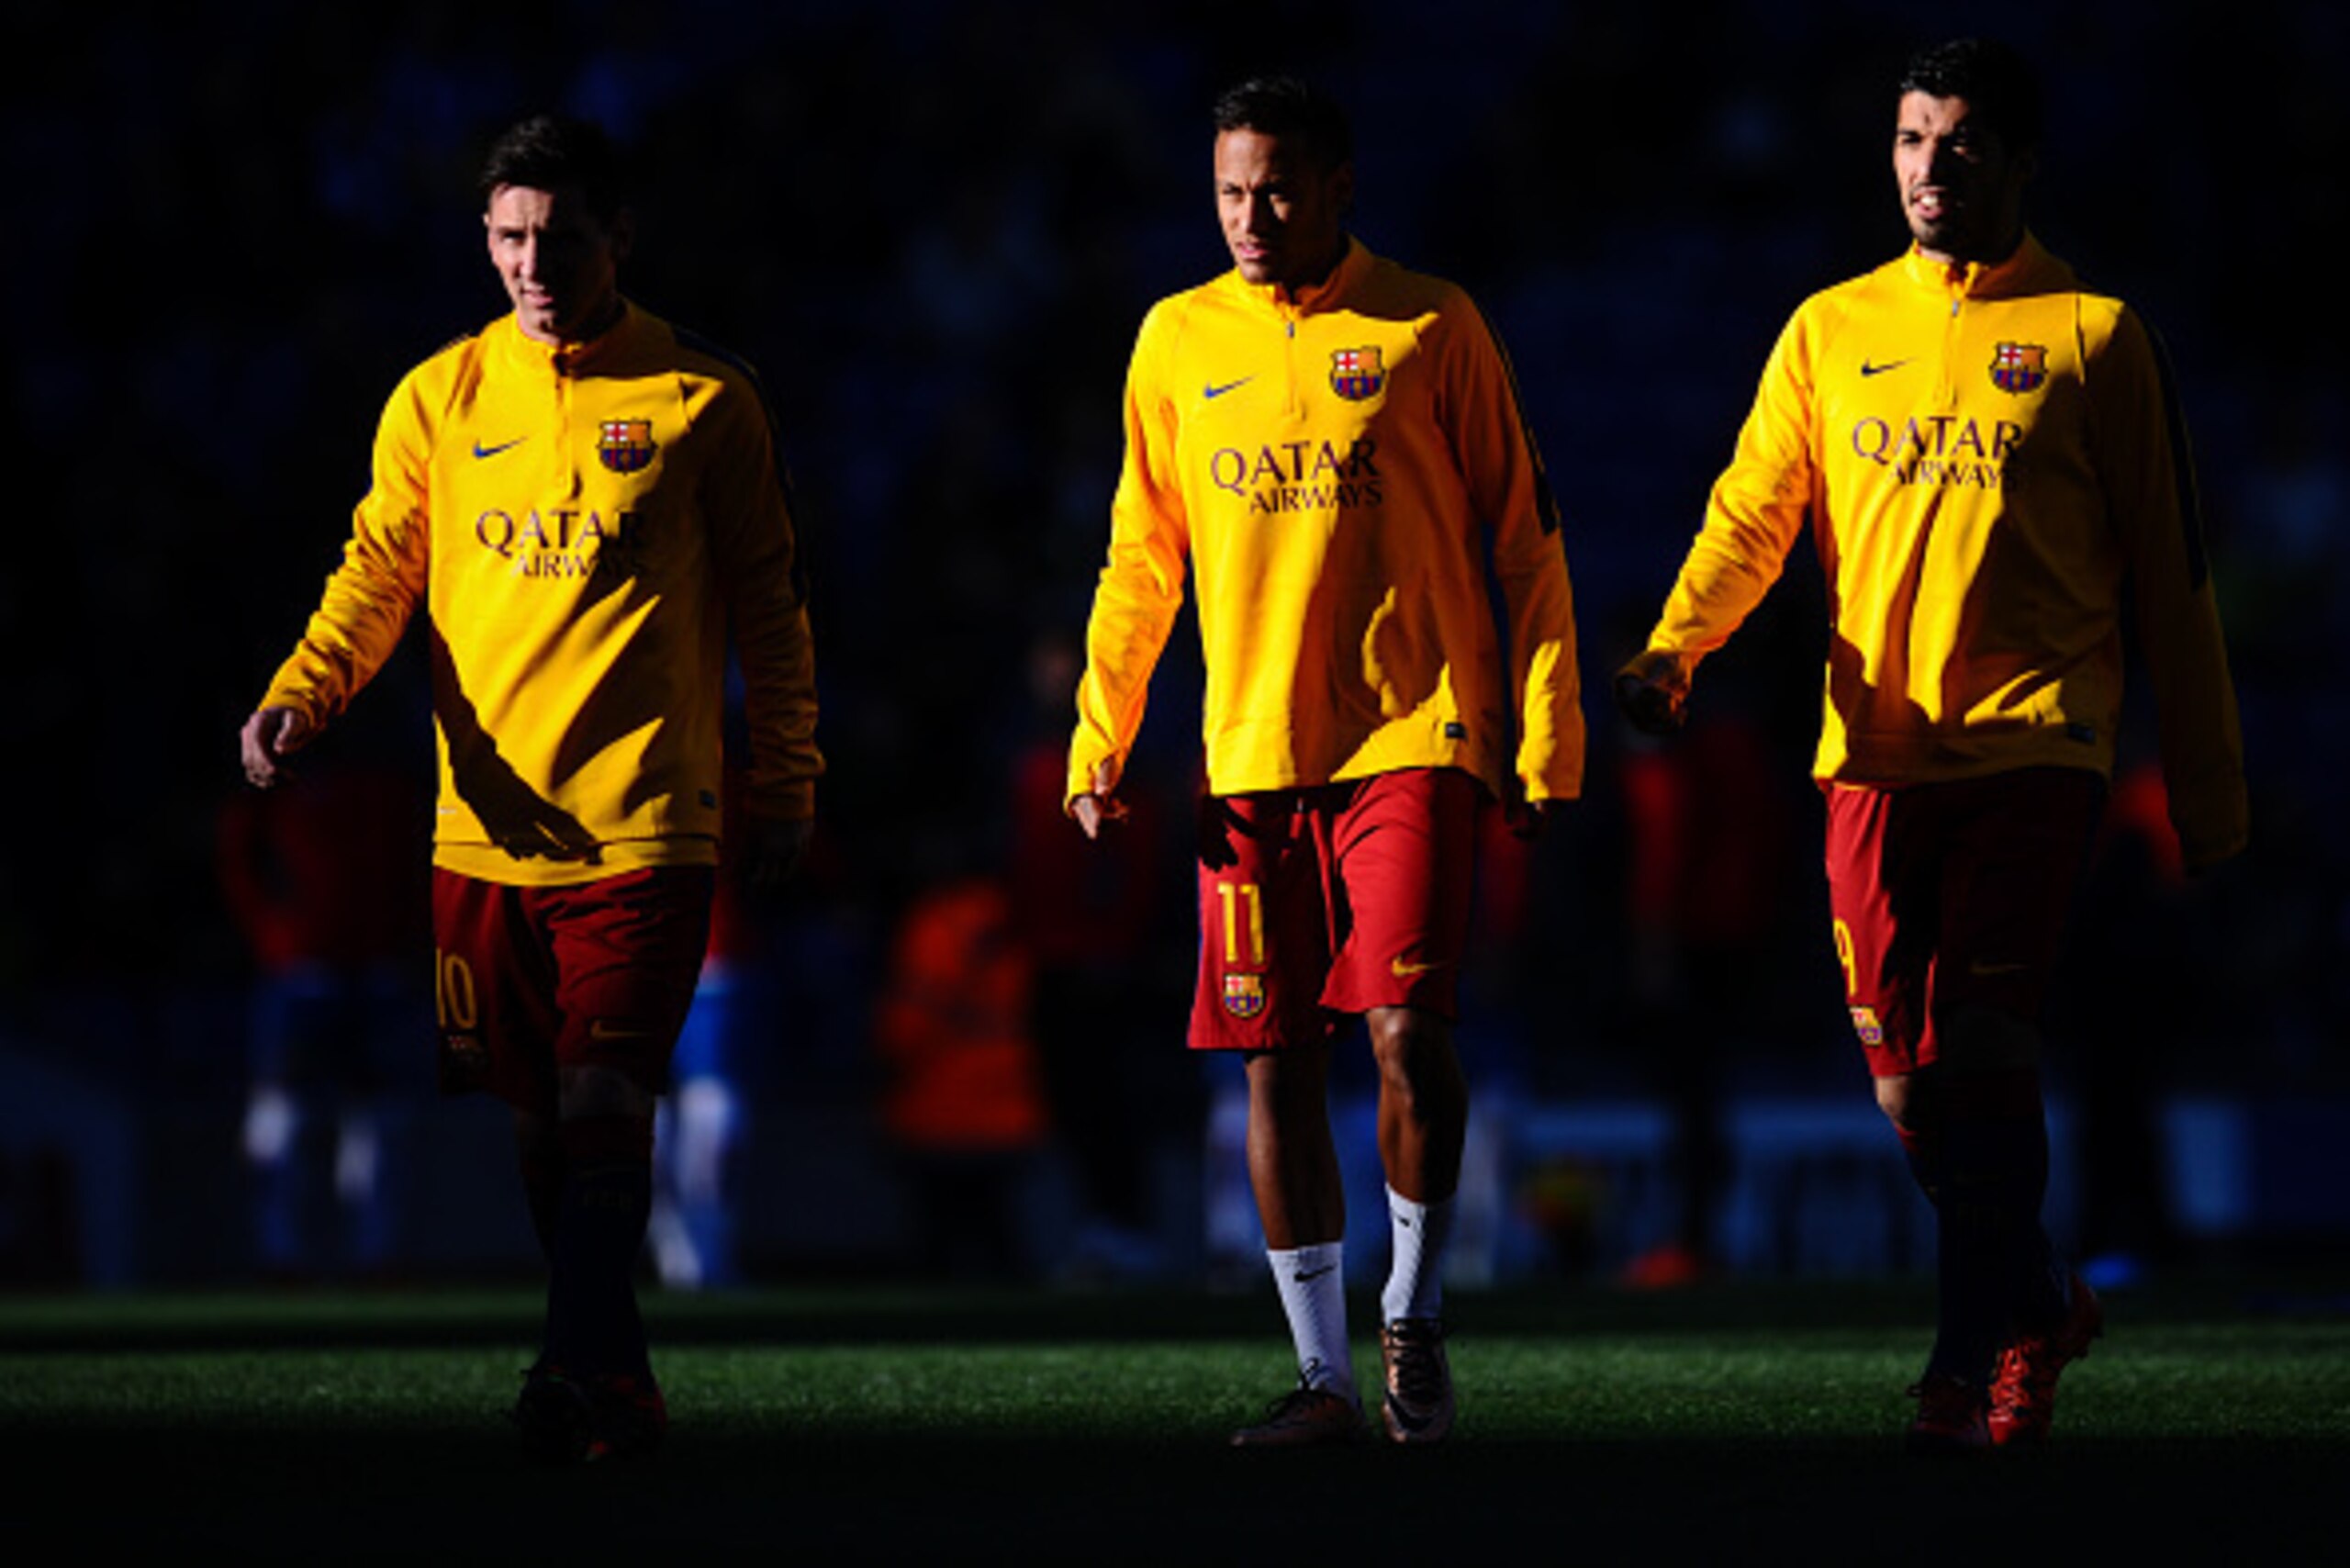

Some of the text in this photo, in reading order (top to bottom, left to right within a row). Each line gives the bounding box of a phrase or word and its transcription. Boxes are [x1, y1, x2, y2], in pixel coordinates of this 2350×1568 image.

[1211, 440, 1380, 496] QATAR
[1852, 416, 2027, 465] QATAR
[1249, 480, 1382, 513] AIRWAYS
[476, 509, 646, 558] QATAR
[1217, 880, 1265, 965] 11
[1831, 915, 1859, 998] 9
[433, 946, 479, 1030] 10
